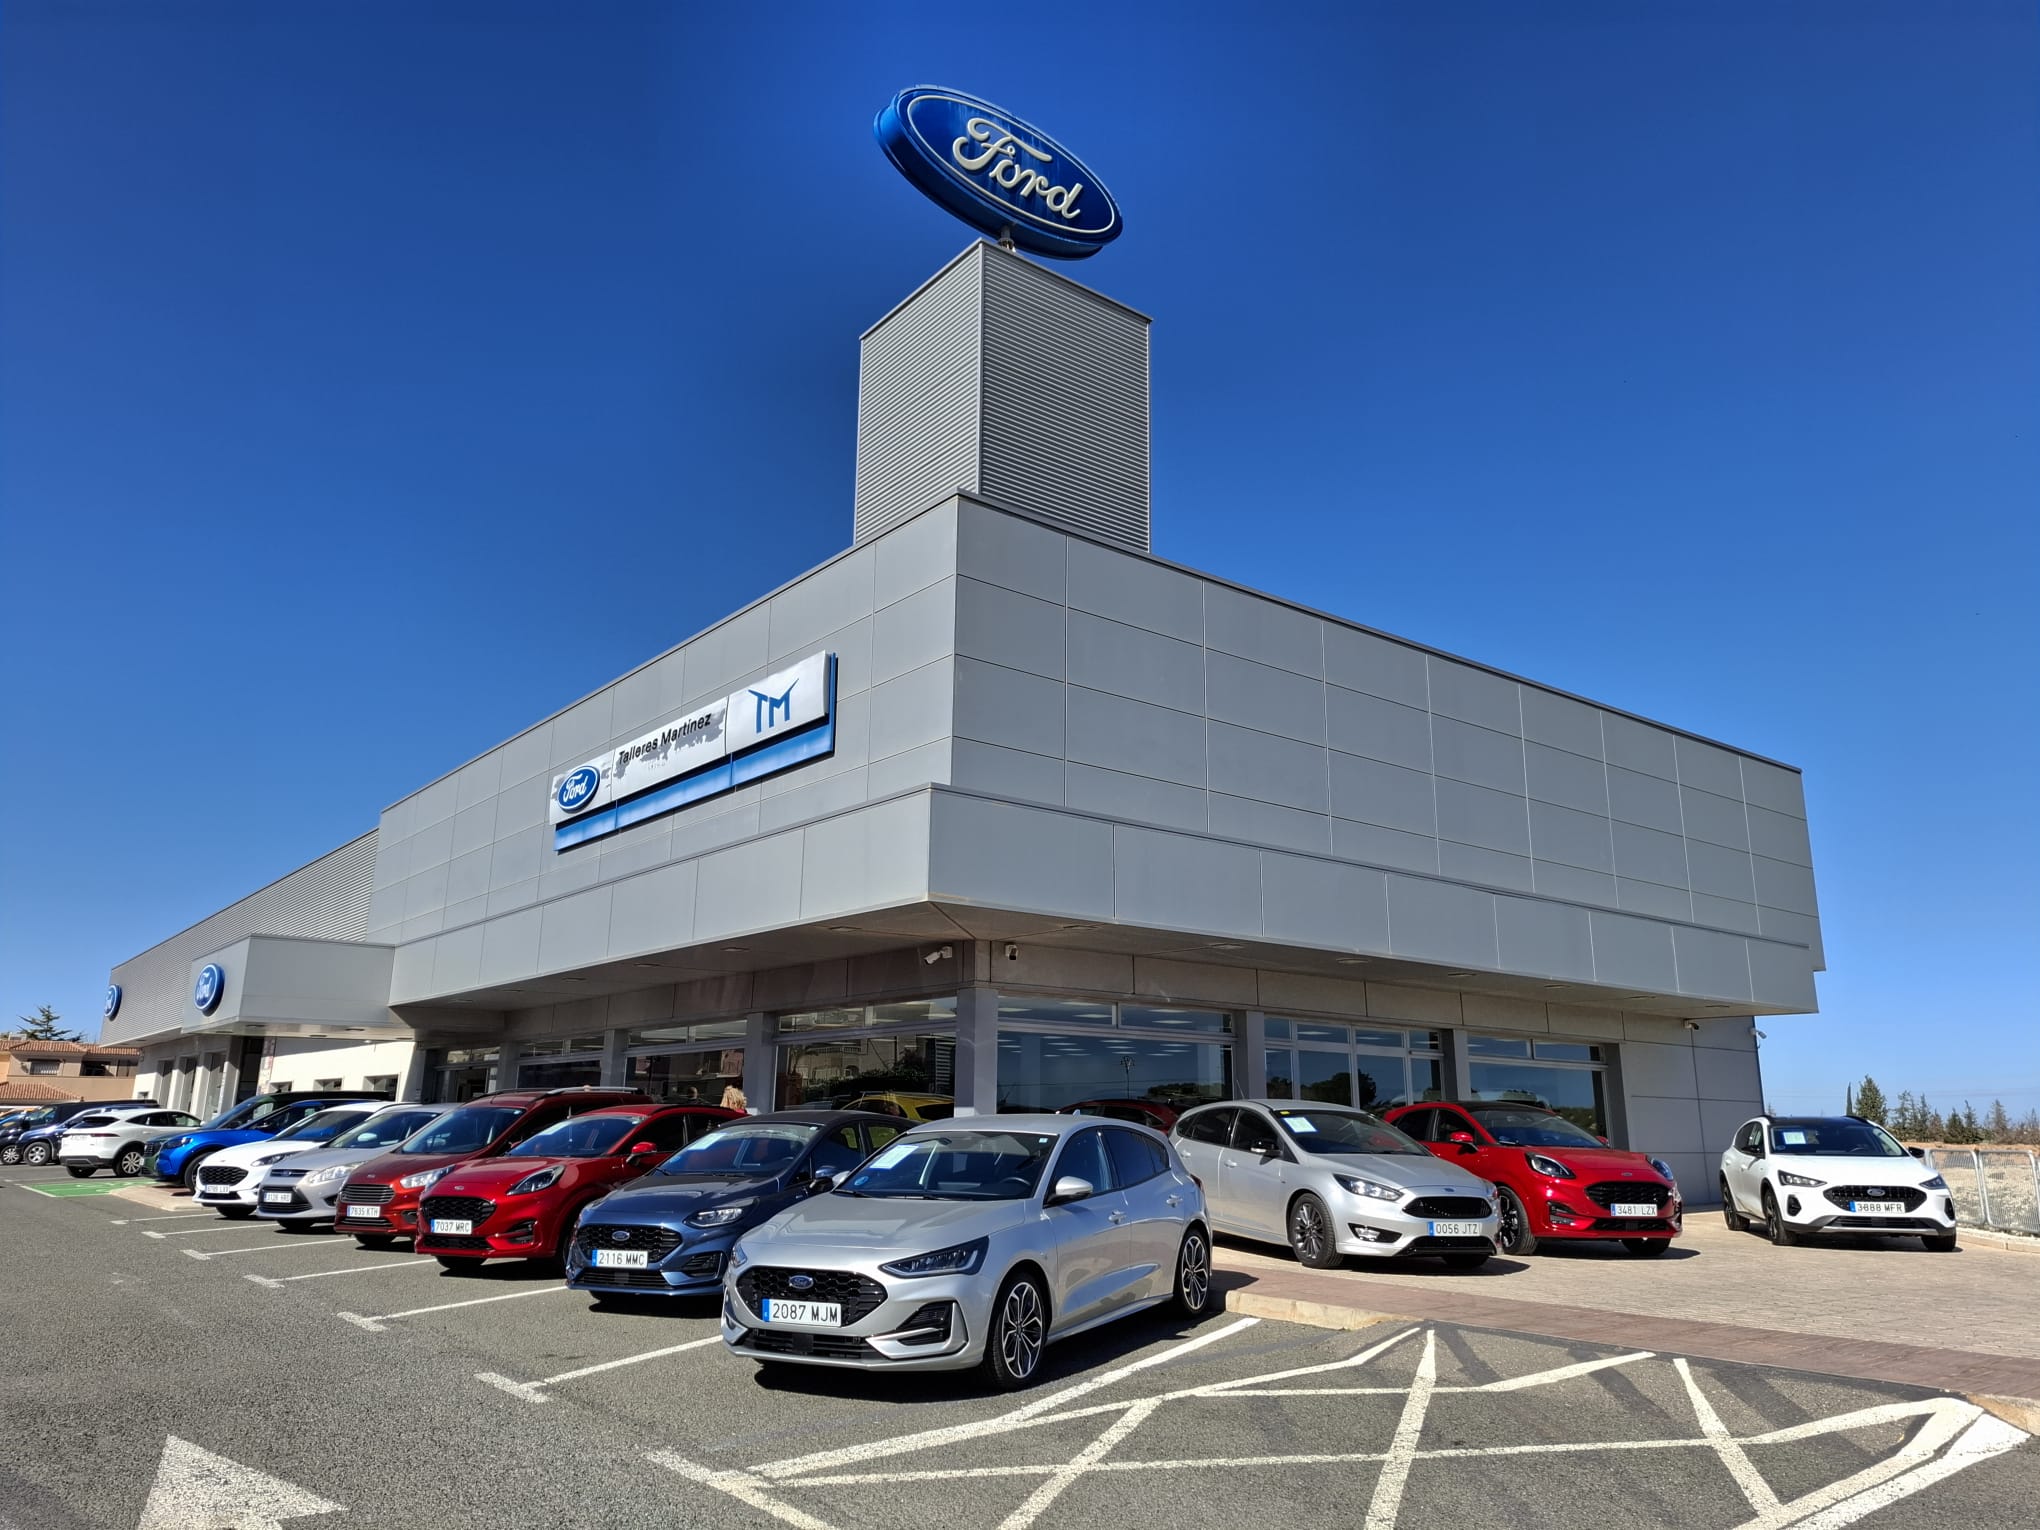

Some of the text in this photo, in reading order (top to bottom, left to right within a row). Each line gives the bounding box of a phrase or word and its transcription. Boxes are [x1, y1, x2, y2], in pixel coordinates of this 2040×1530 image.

[952, 117, 1083, 219] Ford
[618, 738, 659, 765] Talleres
[563, 773, 589, 803] Ford
[1617, 1205, 1656, 1216] 3481 LZX
[436, 1221, 454, 1232] 7037
[1436, 1223, 1478, 1234] 0056 JTZ
[599, 1252, 645, 1266] 2116 MMC
[773, 1303, 838, 1323] 2087 MJM
